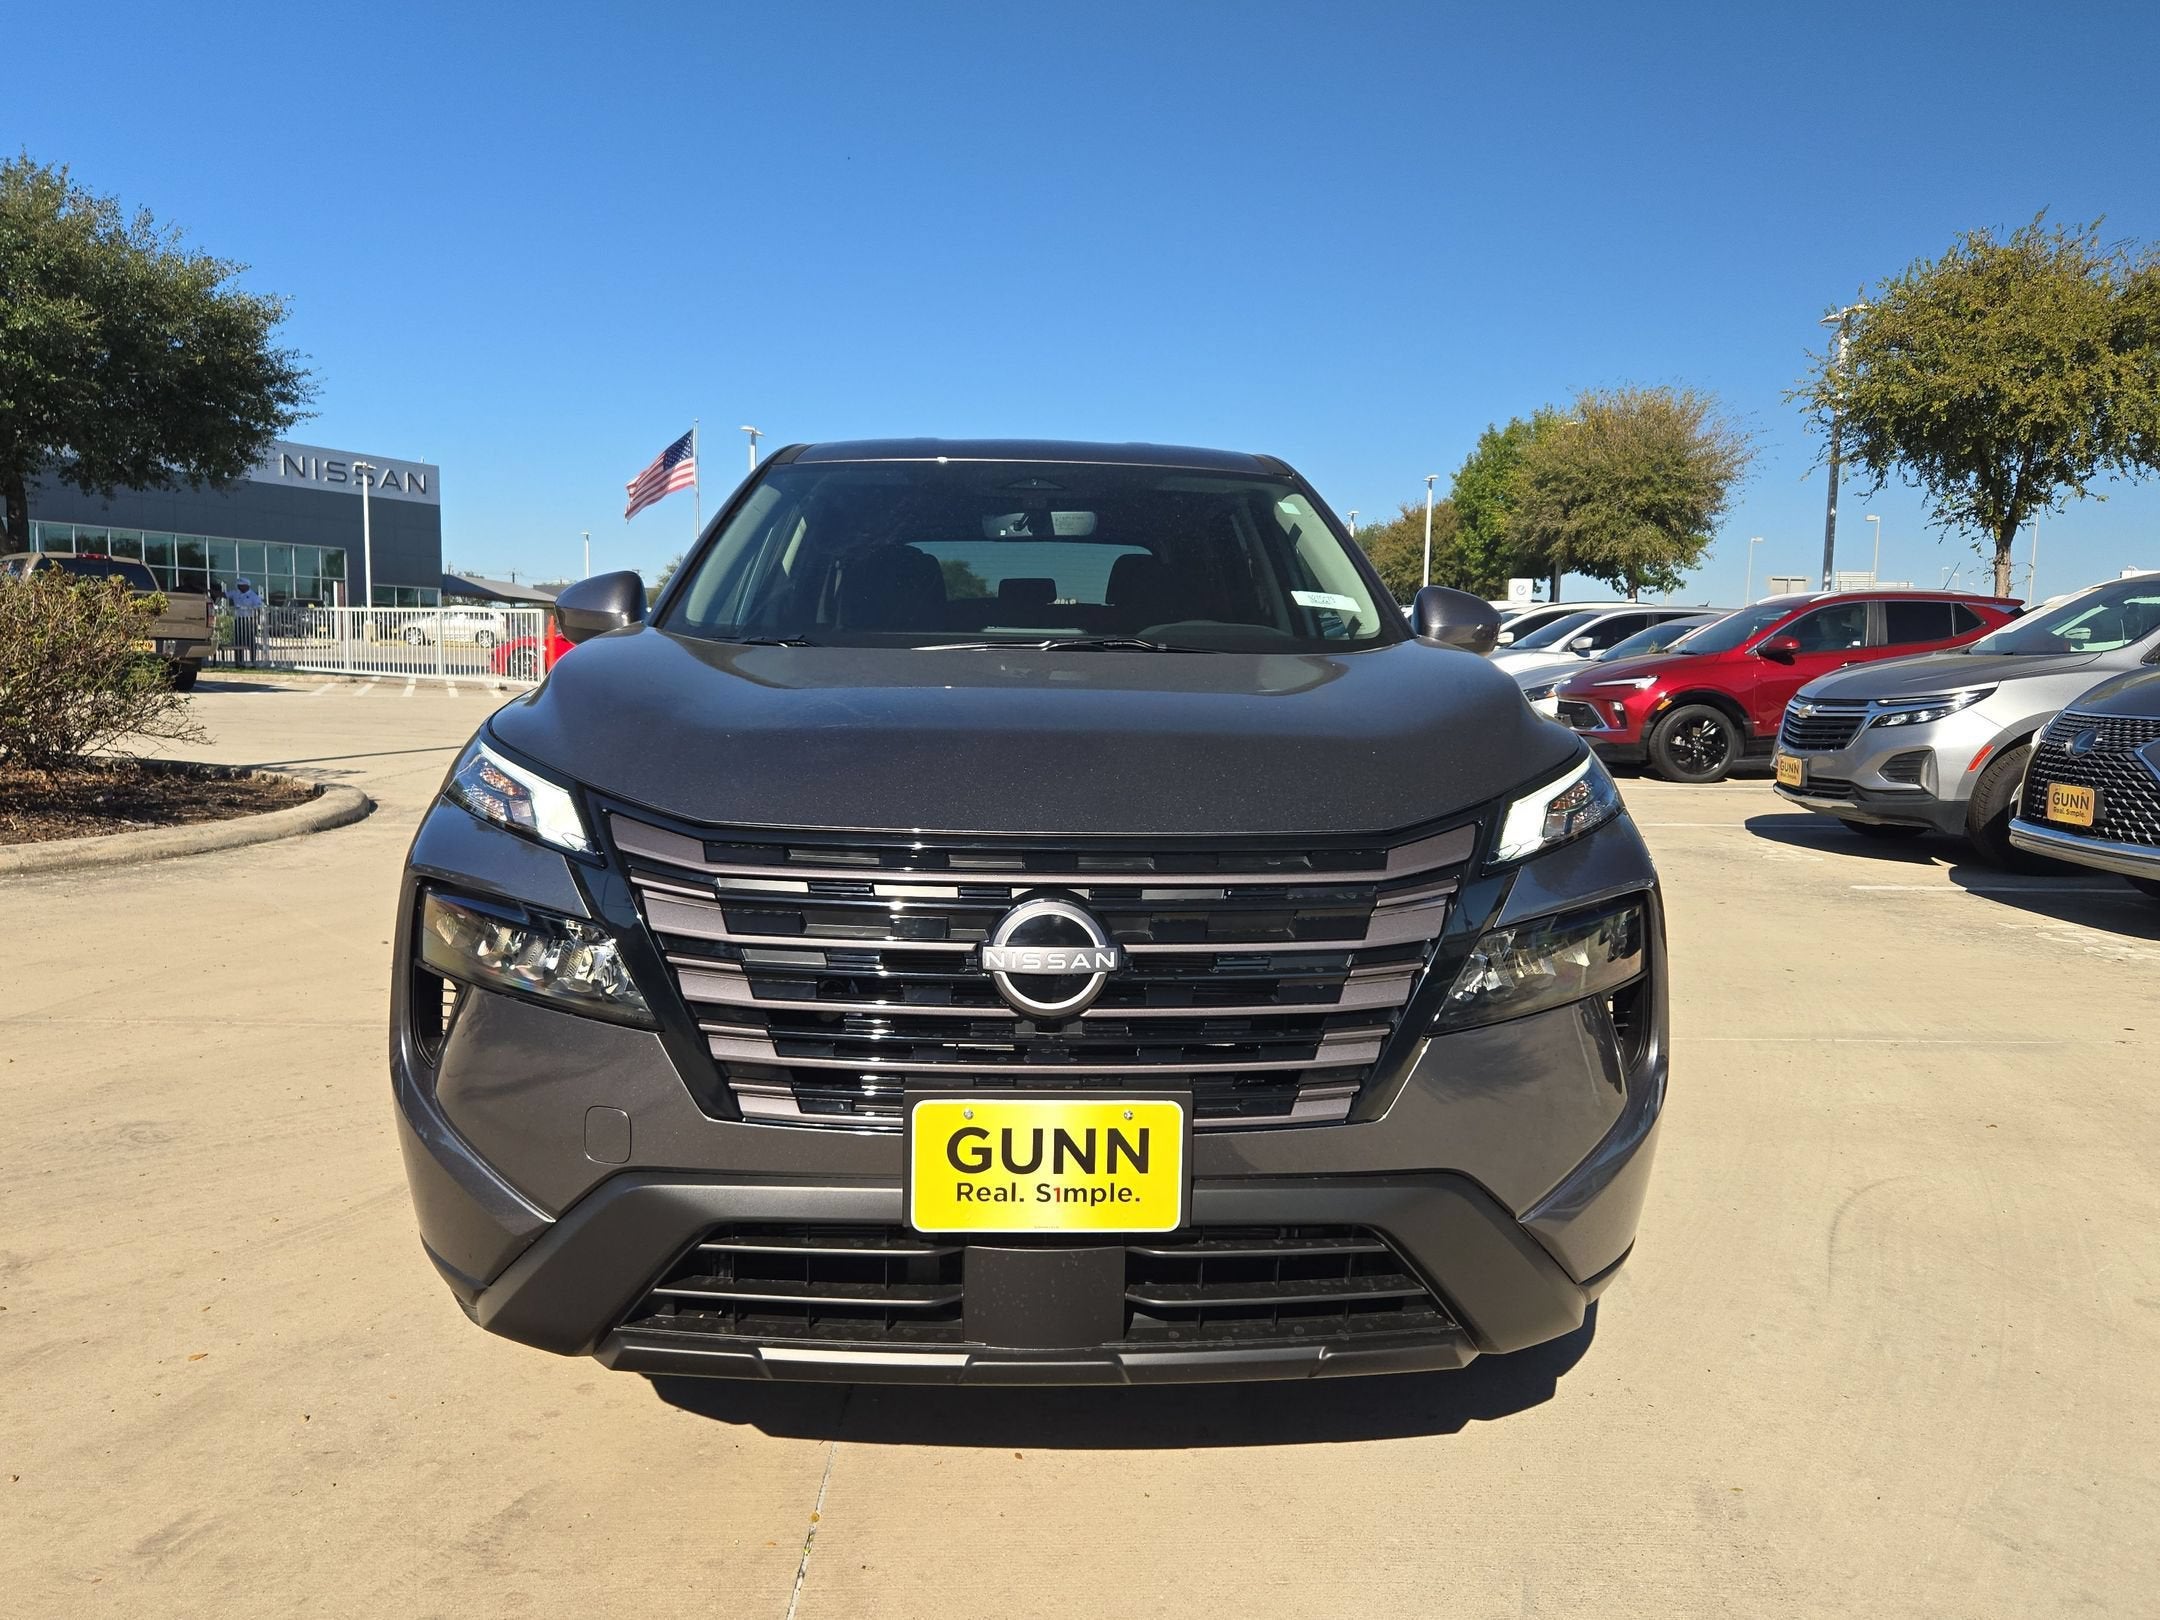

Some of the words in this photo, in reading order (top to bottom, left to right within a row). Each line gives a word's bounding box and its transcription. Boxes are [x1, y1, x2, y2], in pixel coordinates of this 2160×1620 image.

[280, 453, 427, 494] NISSAN
[1780, 760, 1800, 775] GUNN
[2052, 791, 2090, 811] GUNN
[984, 951, 1115, 969] NISSAN
[946, 1126, 1150, 1175] GUNN
[956, 1182, 1025, 1203] Real.
